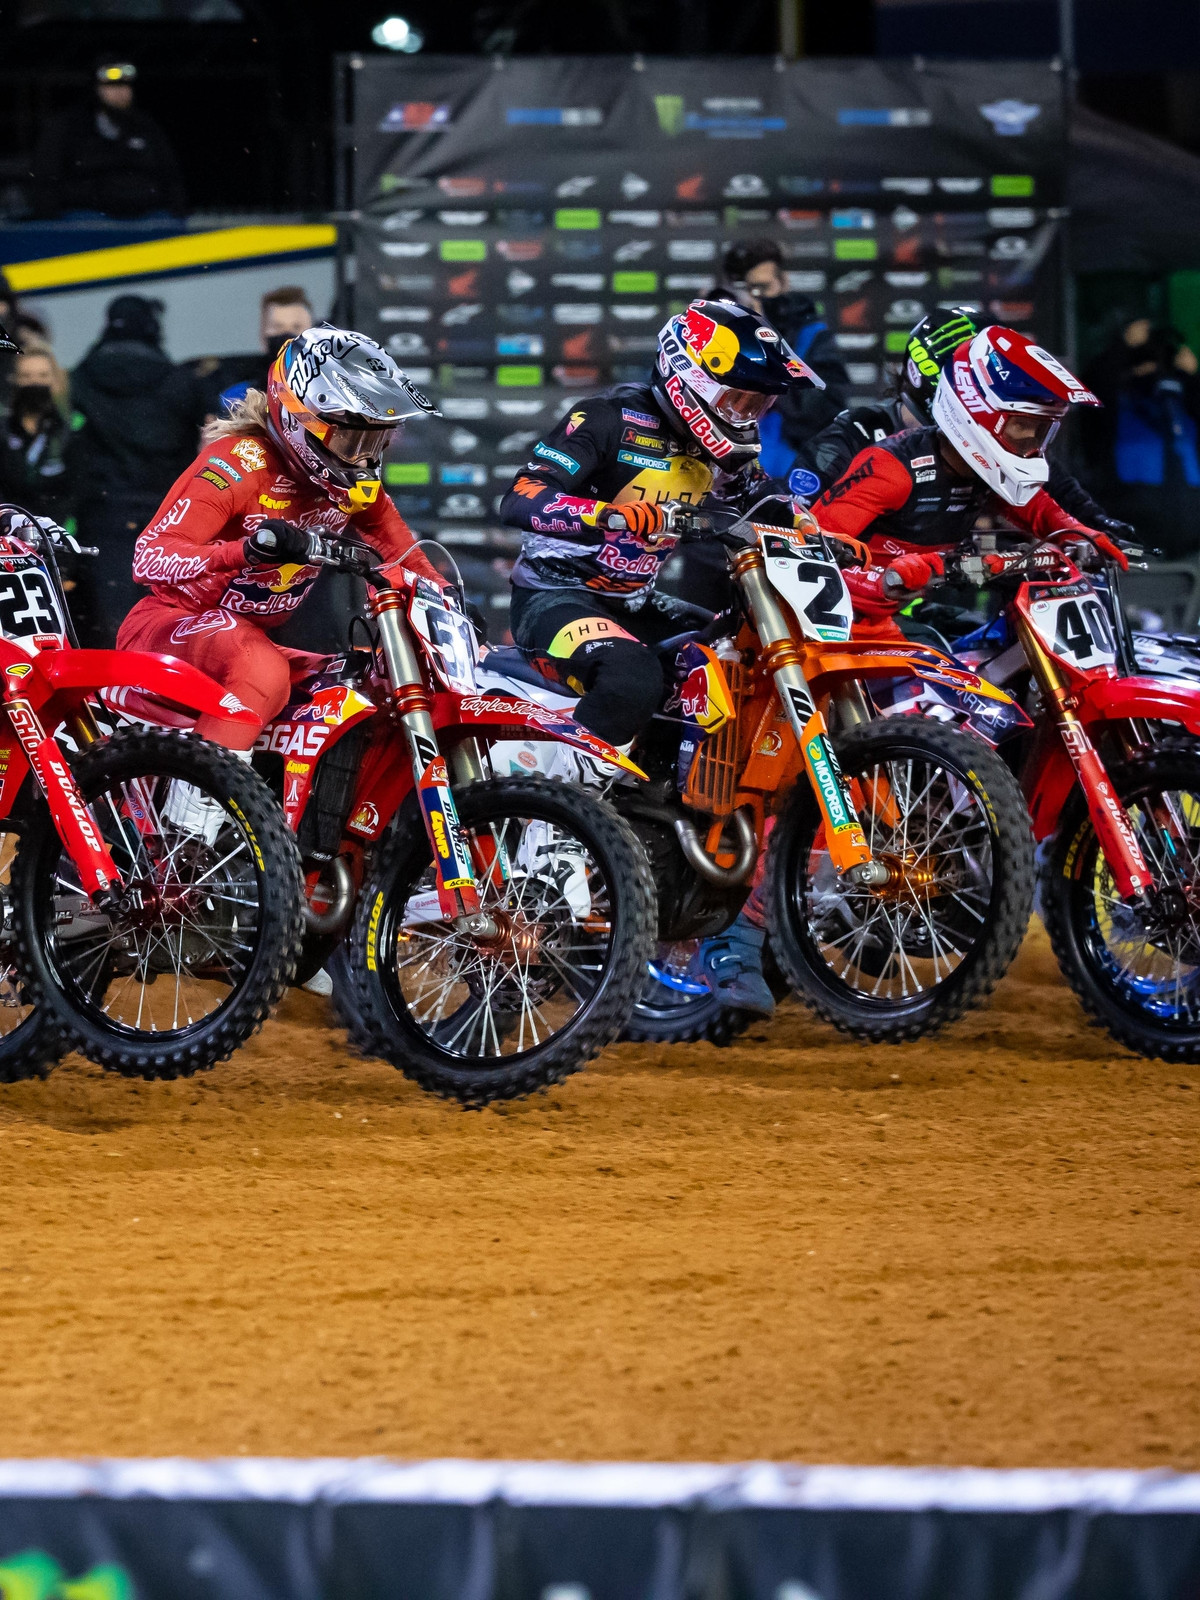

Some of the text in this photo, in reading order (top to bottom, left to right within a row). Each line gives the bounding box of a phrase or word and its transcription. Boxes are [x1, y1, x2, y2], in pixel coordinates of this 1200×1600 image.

[759, 331, 777, 339] BELL
[954, 360, 993, 414] LEATT
[665, 376, 734, 458] Red Bull
[538, 447, 574, 469] MOTOREX
[633, 456, 668, 470] MOTOREX
[971, 452, 992, 470] LEATT
[598, 546, 640, 573] Red
[797, 562, 849, 629] 2
[1053, 600, 1115, 660] 40
[460, 697, 565, 724] Troy Lee Designs
[680, 740, 695, 752] KTM
[49, 760, 102, 853] DUNLOP
[814, 761, 845, 825] MOTOREX
[1104, 797, 1146, 872] DUNLOP
[368, 891, 385, 972] DUNLOP
